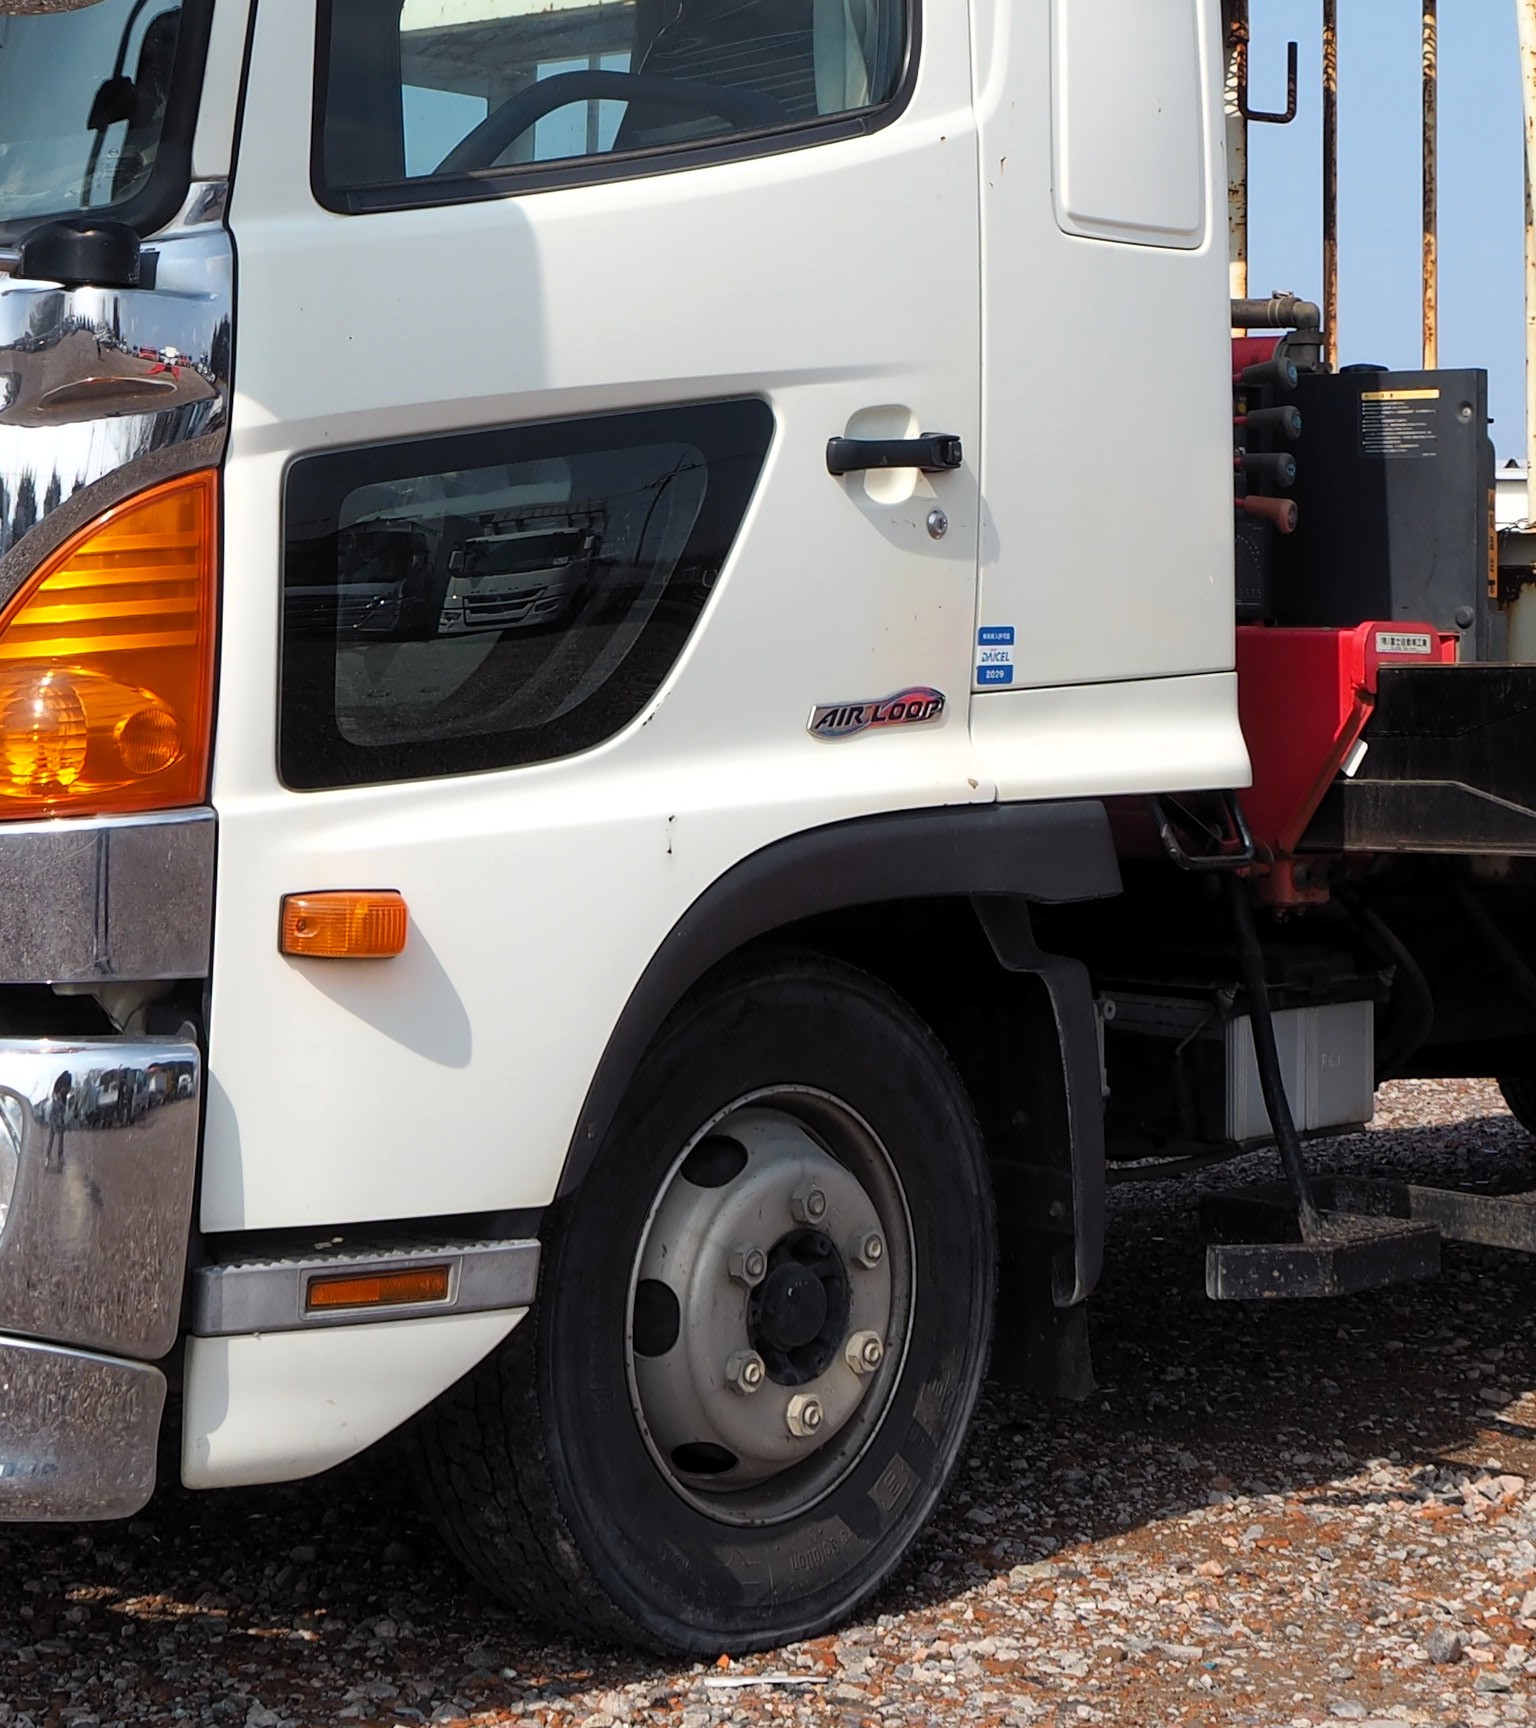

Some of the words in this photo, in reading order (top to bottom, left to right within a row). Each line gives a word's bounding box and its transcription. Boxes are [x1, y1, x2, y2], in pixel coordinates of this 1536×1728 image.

[981, 651, 1010, 662] DAICEL
[815, 705, 865, 730] AIR
[870, 698, 944, 723] LOOP
